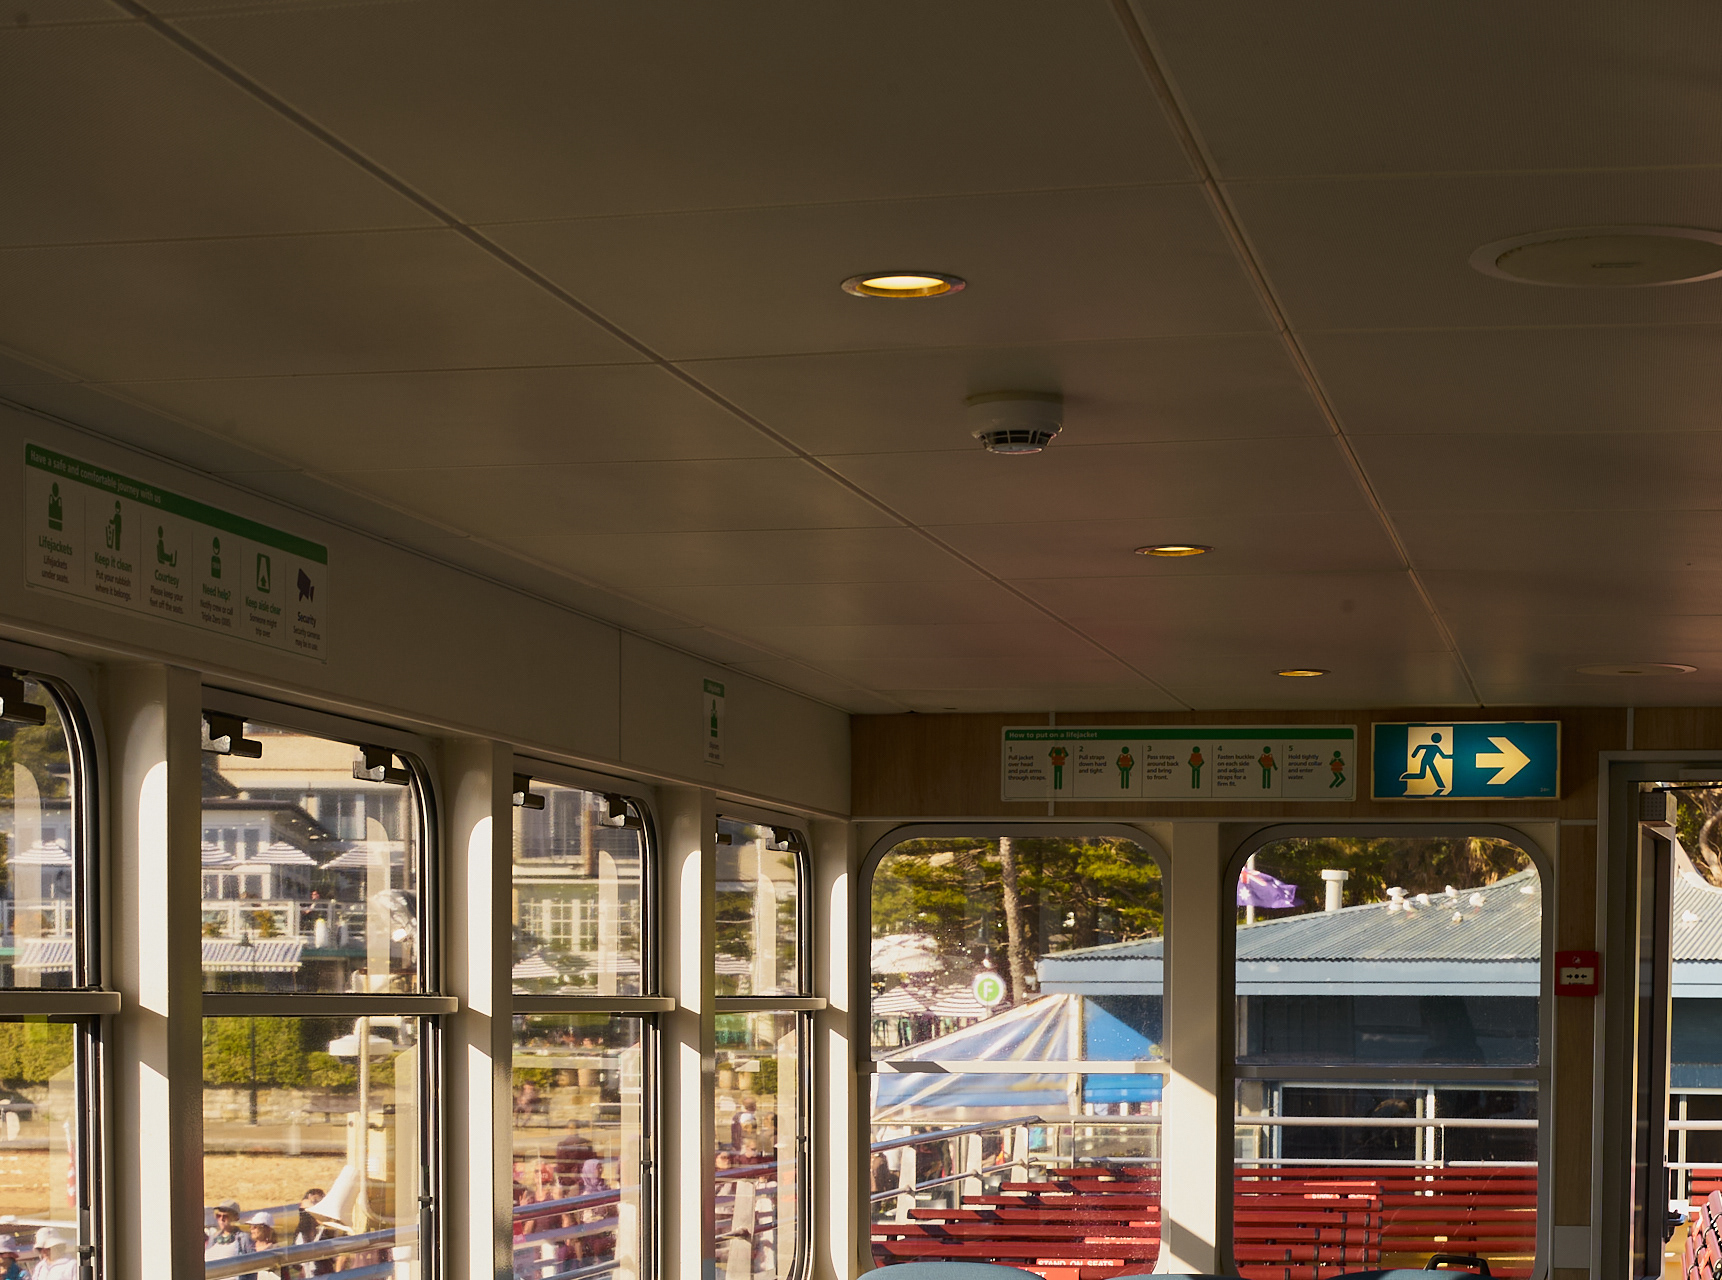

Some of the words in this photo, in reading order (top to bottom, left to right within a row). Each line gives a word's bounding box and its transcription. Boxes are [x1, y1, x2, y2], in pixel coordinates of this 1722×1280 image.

[30, 450, 47, 465] Have
[48, 458, 52, 466] a
[53, 460, 66, 471] safe
[67, 465, 80, 476] and
[80, 469, 117, 488] comfortable
[117, 479, 140, 498] journey
[140, 488, 154, 500] with
[154, 494, 162, 503] us
[38, 535, 72, 556] Lifejackets
[43, 555, 68, 570] Lifejackets
[94, 552, 110, 569] Keep
[111, 555, 116, 568] it
[116, 558, 132, 573] clean
[96, 570, 104, 580] Put
[154, 569, 180, 589] Courtesy
[202, 583, 216, 598] Need
[216, 586, 232, 603] help?
[246, 596, 258, 612] Keep
[270, 602, 282, 616] clear
[298, 611, 317, 628] Security
[1036, 732, 1048, 740] put
[1066, 731, 1098, 740] lifejacket
[984, 981, 994, 998] F
